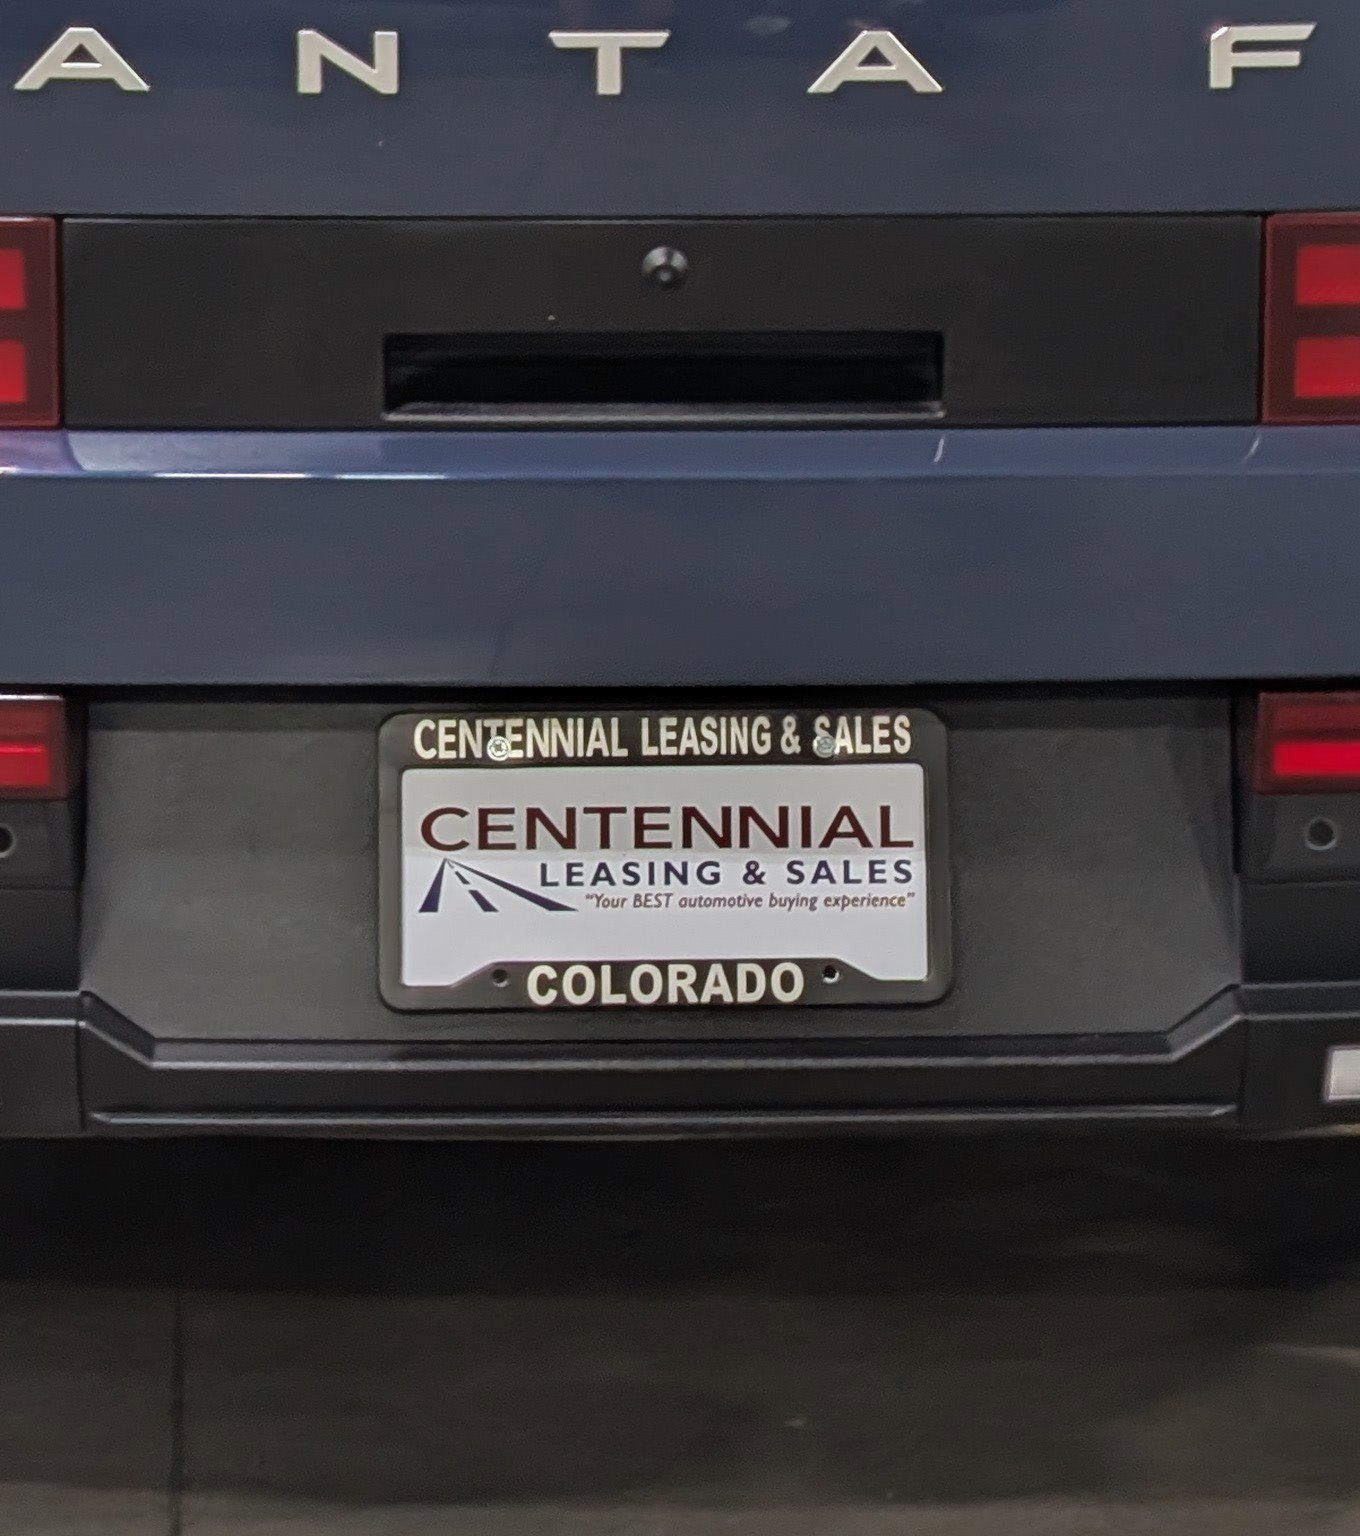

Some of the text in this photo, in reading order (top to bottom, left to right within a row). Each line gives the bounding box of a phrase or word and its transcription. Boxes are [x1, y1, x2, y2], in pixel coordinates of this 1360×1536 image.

[413, 714, 912, 761] CENTENNIAL LEASING & SALES
[420, 805, 914, 851] CENTENNIAL
[540, 860, 913, 887] LEASING & SALES
[633, 893, 673, 908] BEST
[678, 892, 763, 908] automotive
[768, 892, 818, 911] buying
[526, 962, 805, 1005] COLORADO
